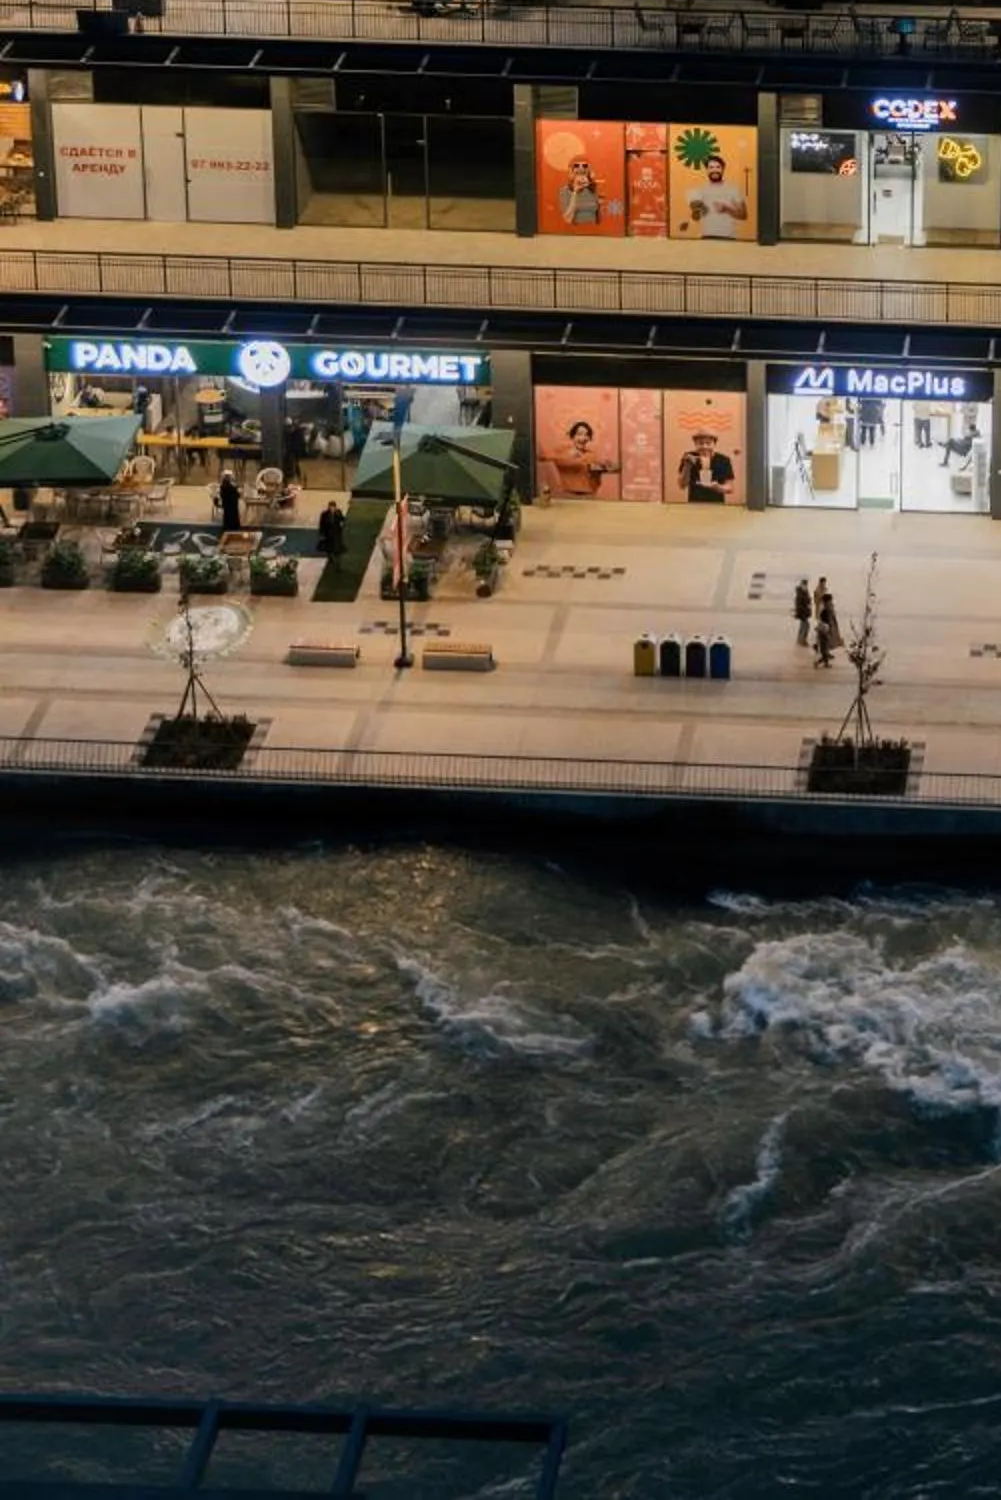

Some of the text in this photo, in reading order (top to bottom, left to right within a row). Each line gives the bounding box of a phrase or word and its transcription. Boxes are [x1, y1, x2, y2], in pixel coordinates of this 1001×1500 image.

[872, 98, 957, 120] CODEX
[73, 341, 483, 382] PANDA GOURMET
[846, 369, 966, 396] MacPlus
